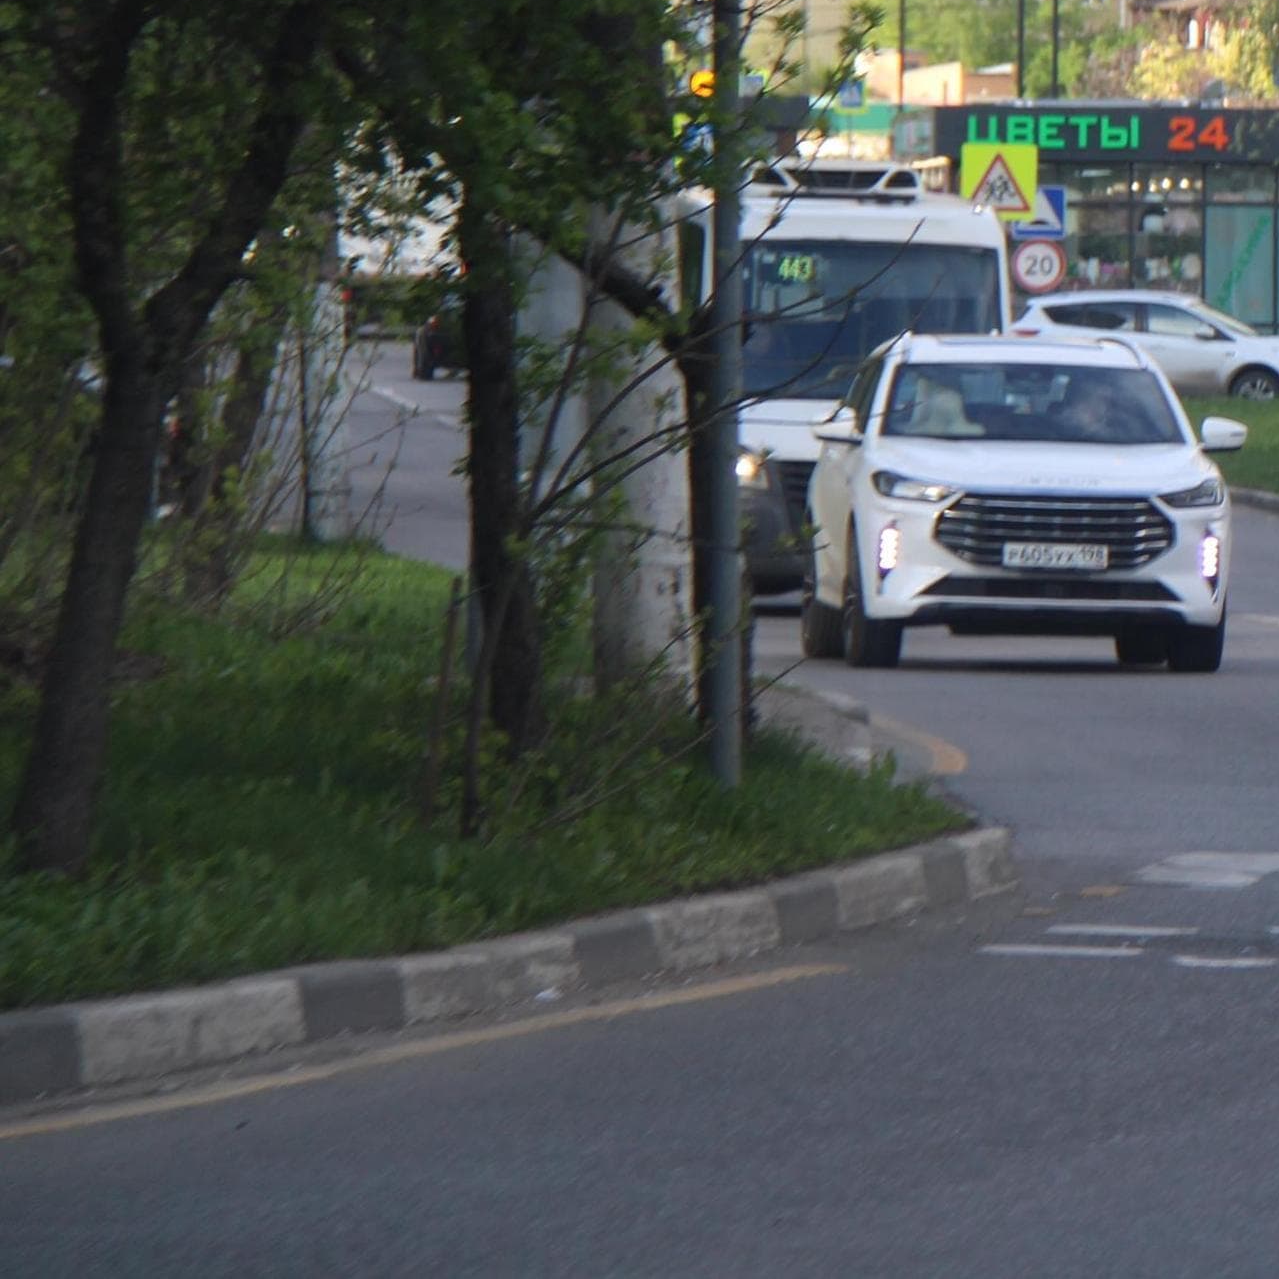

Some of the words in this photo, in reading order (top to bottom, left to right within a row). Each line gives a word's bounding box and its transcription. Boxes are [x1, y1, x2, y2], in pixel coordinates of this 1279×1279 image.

[967, 115, 1140, 149] ЦВЕТЫ
[1167, 116, 1230, 151] 24
[1024, 254, 1054, 276] 20
